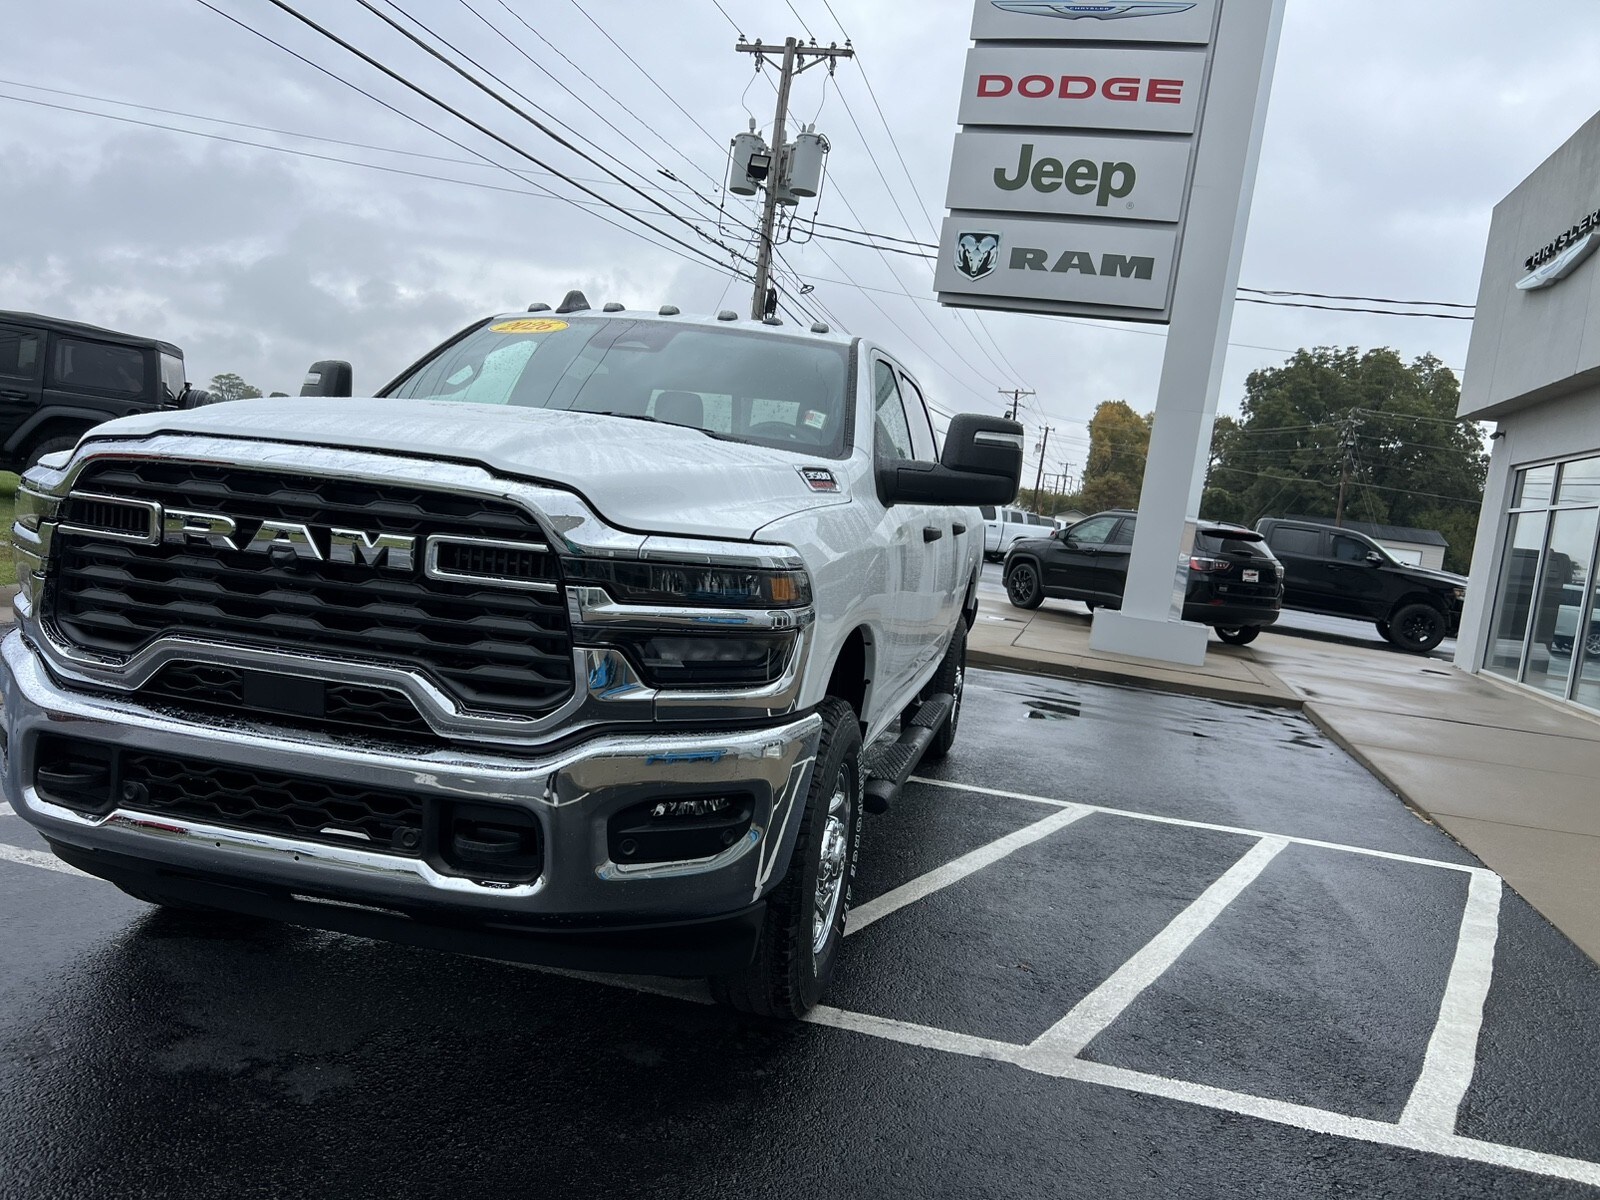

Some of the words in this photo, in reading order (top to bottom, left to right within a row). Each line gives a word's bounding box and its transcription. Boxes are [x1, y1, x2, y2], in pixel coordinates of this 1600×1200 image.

[976, 74, 1185, 105] DODGE
[993, 143, 1136, 207] Jeep
[1008, 246, 1155, 281] RAM
[804, 471, 831, 480] 3500
[163, 507, 417, 571] RAM
